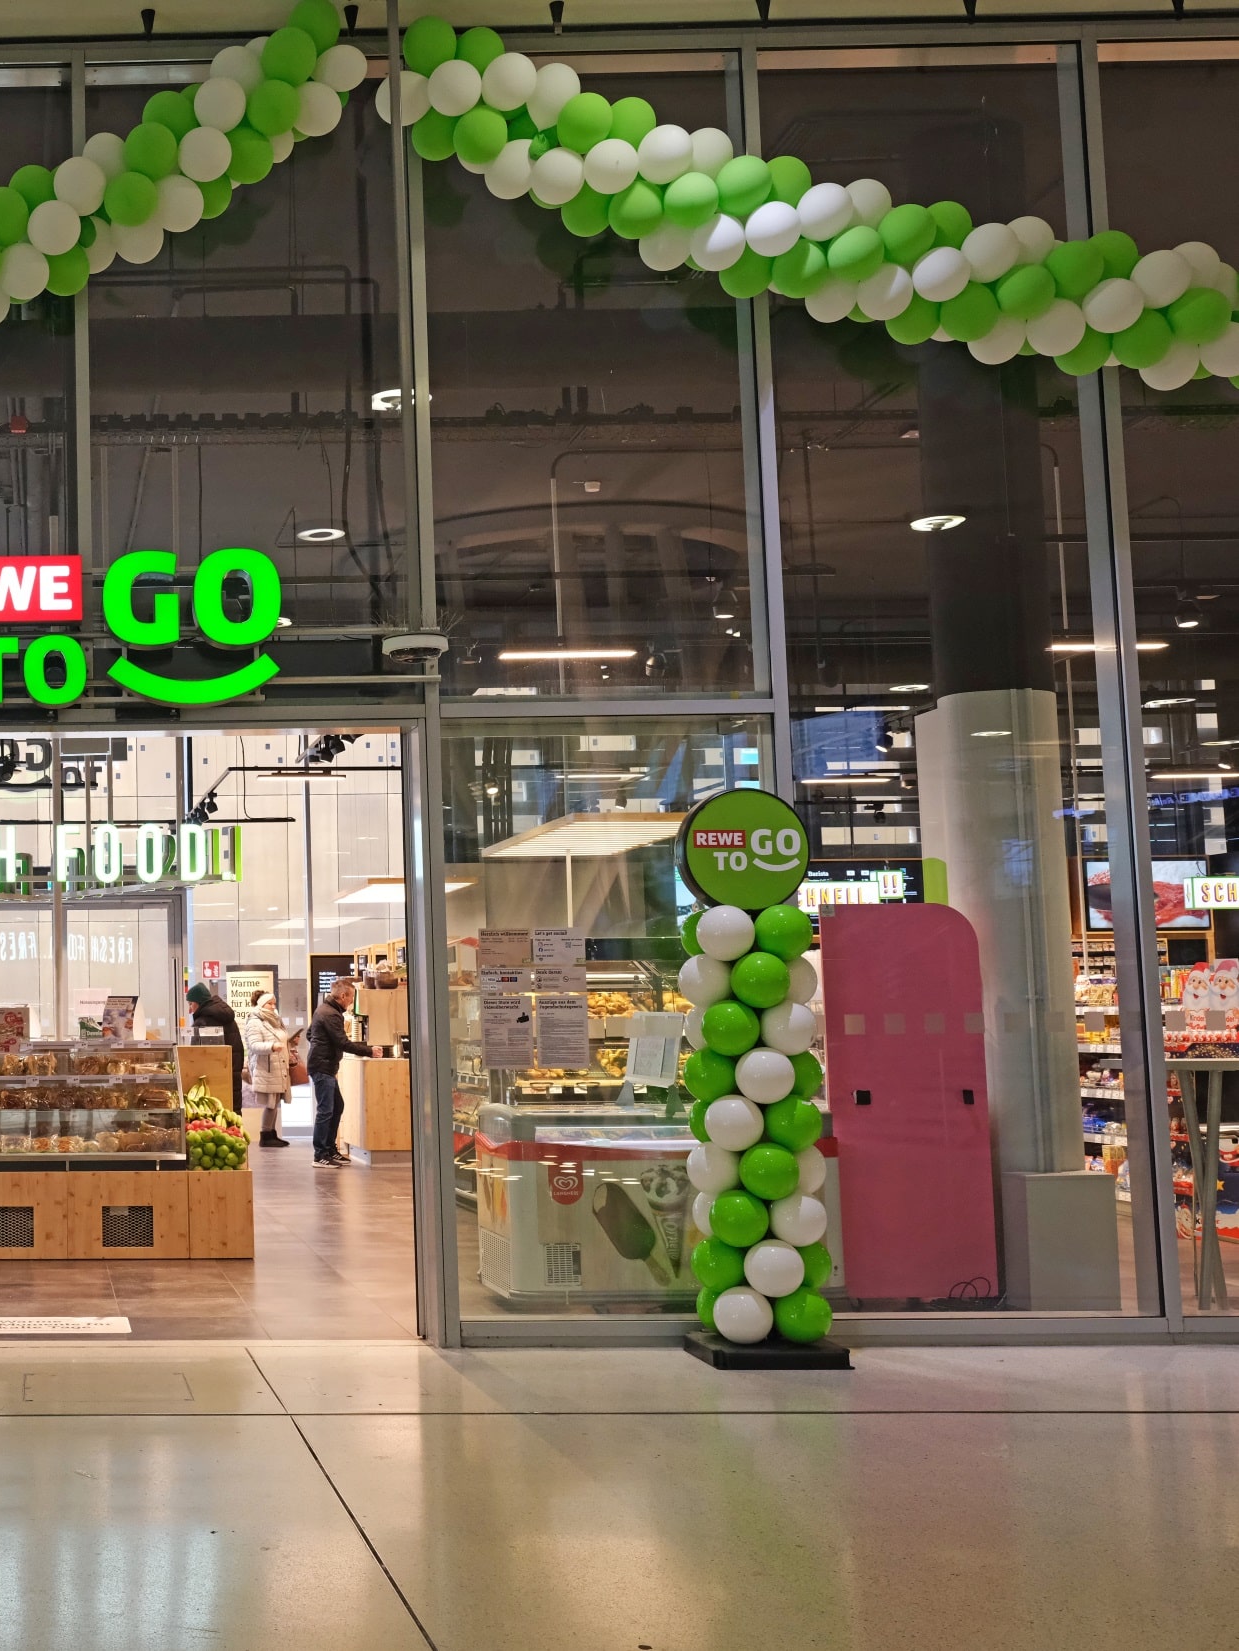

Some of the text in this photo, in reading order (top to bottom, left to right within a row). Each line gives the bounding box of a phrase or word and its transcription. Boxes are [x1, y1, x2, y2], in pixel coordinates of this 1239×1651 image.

[102, 548, 282, 647] GO
[696, 828, 801, 856] REWE GO
[713, 851, 748, 872] TO
